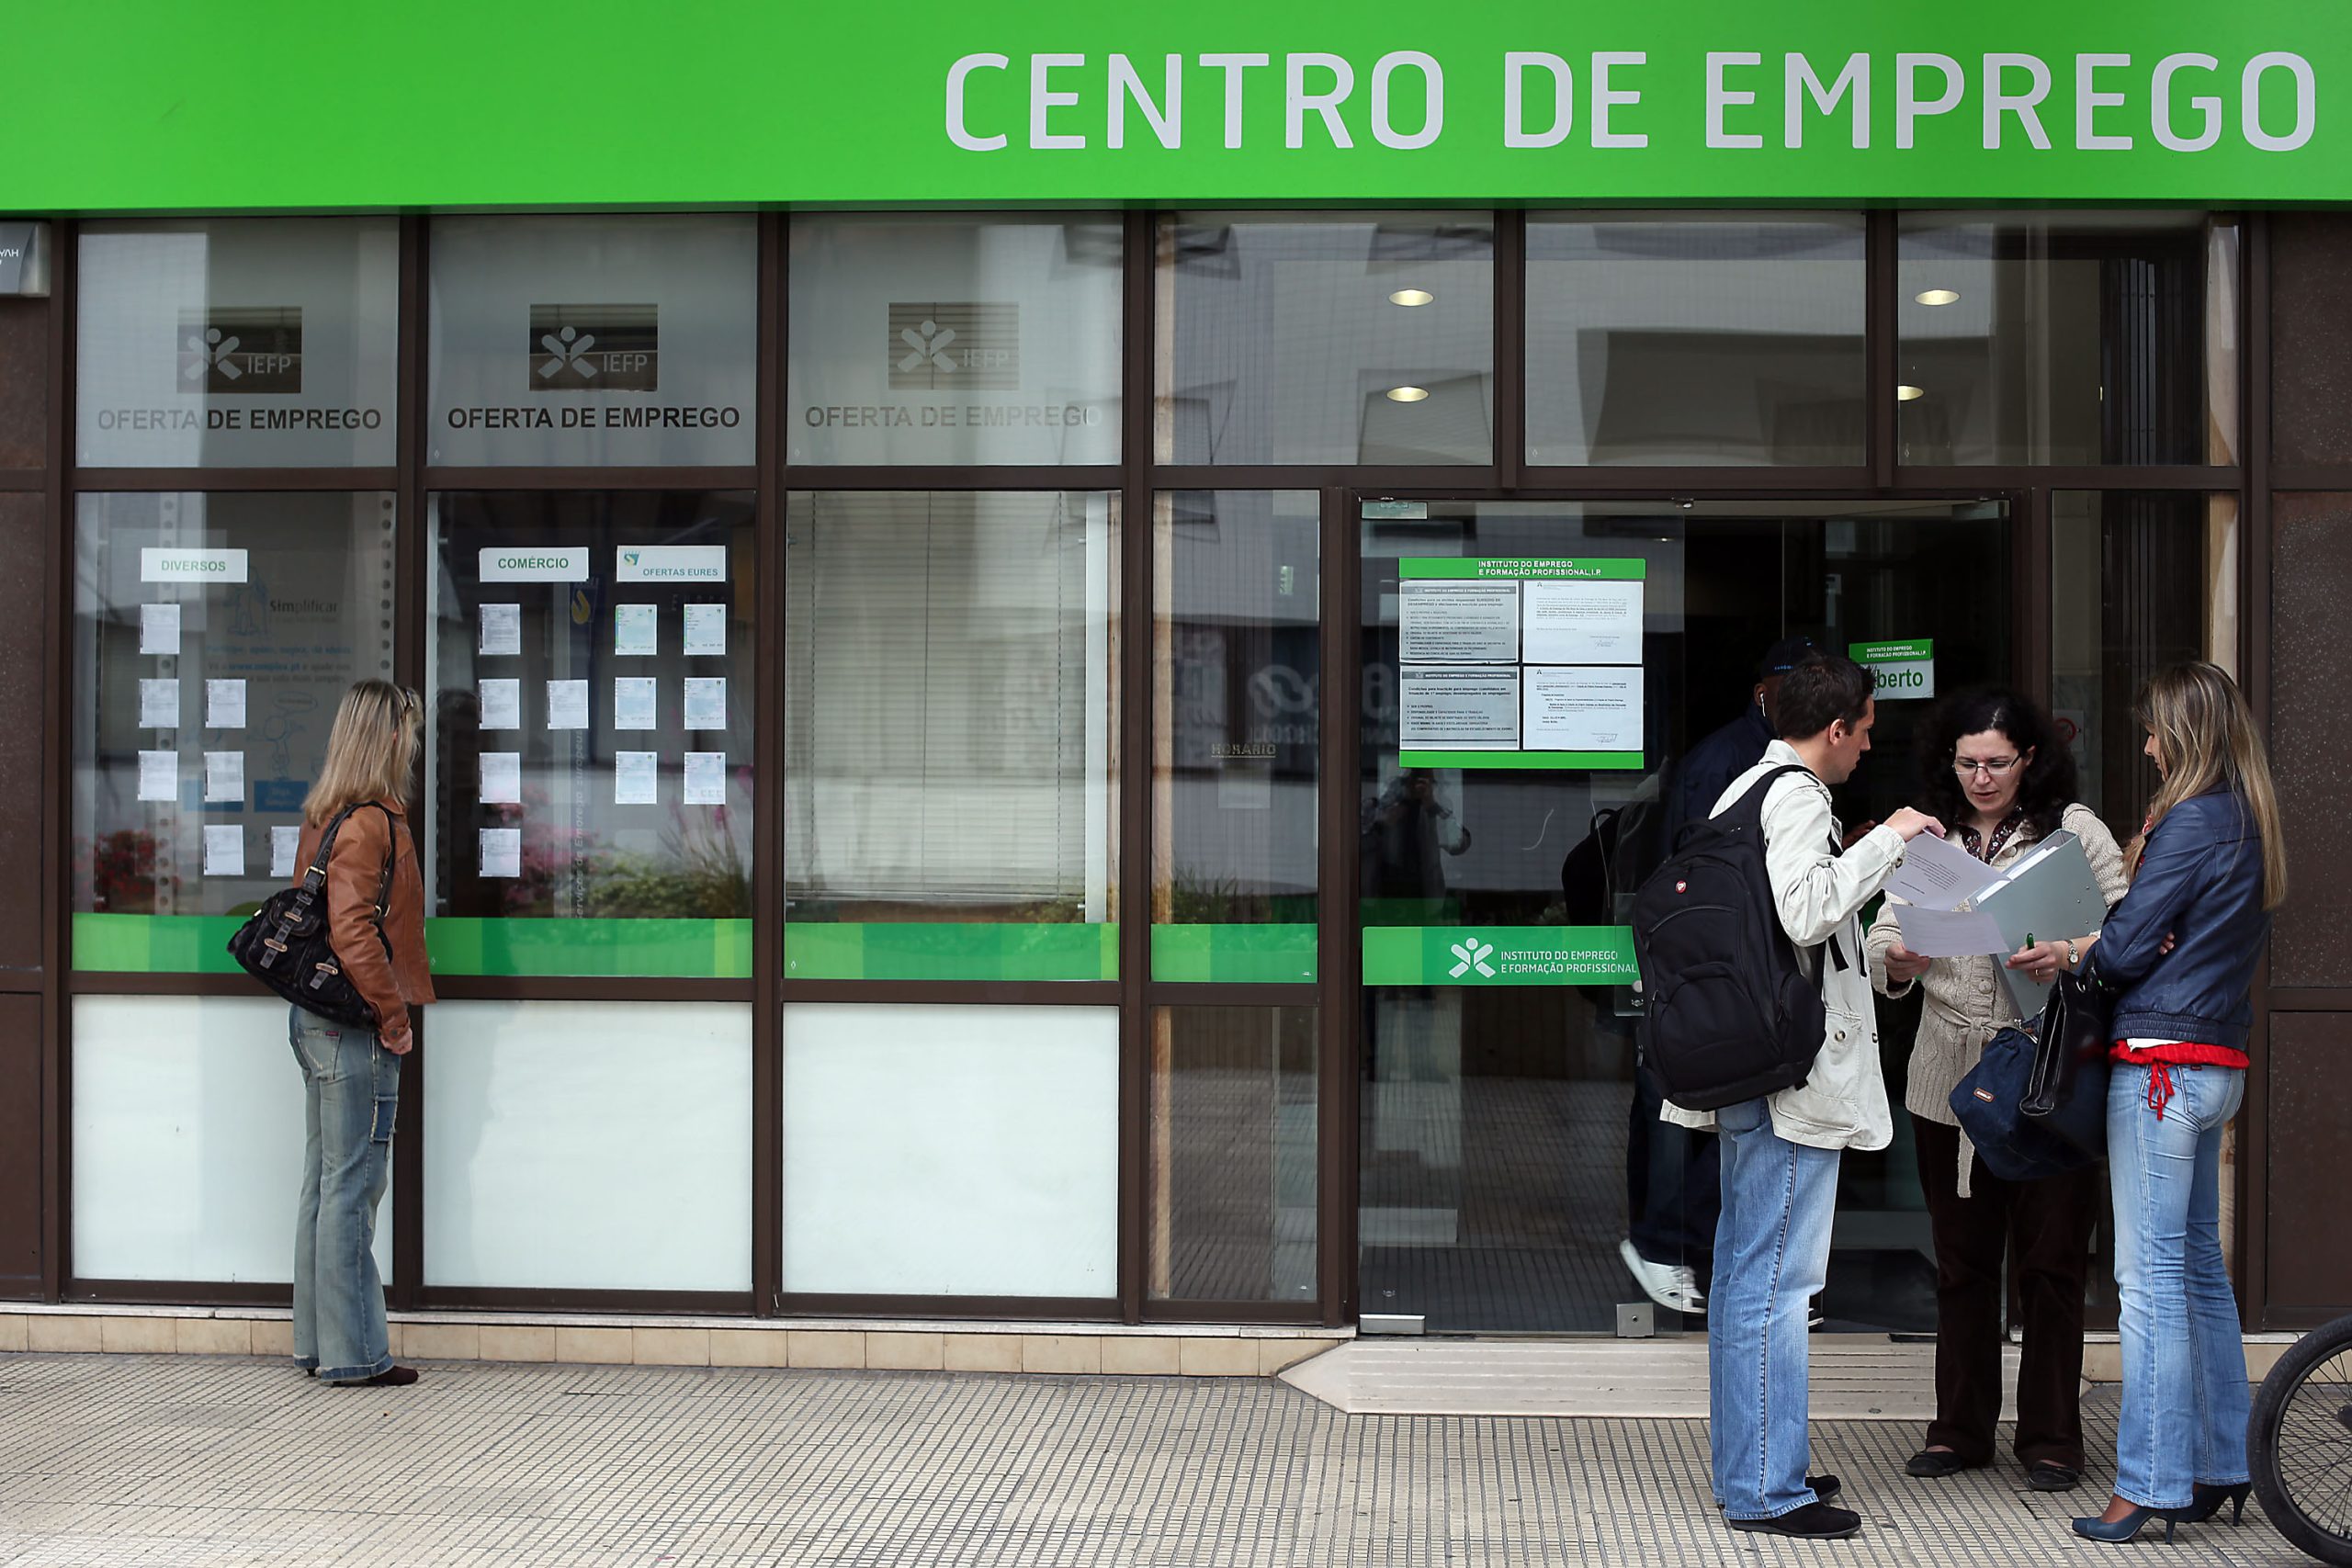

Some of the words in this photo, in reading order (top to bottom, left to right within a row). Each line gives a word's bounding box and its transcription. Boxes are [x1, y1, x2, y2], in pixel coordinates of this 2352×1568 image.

[945, 51, 1443, 152] CENTRO
[1504, 51, 1648, 148] DE
[1706, 51, 2316, 152] EMPREGO
[247, 355, 291, 375] IEFP
[603, 353, 648, 373] IEFP
[964, 348, 1009, 368] IEFP
[98, 409, 199, 431] OFERTA
[207, 410, 241, 430] DE
[250, 409, 381, 431] EMPREGO
[447, 407, 553, 429] OFERTA
[561, 407, 596, 428] DE
[605, 406, 741, 429] EMPREGO
[805, 406, 912, 428] OFERTA
[922, 406, 956, 427] DE
[966, 405, 1102, 428] EMPREGO
[161, 559, 226, 572] DIVERSOS
[497, 555, 570, 569] COMÉRCIO
[1486, 567, 1531, 577] FORMAÇÃO
[643, 568, 685, 577] OFERTAS
[687, 568, 718, 577] EURES
[1876, 668, 1924, 689] berto
[1500, 951, 1553, 961] INSTITUTO
[1555, 951, 1568, 961] DO
[1571, 951, 1618, 961] EMPREGO
[1501, 964, 1507, 974] E
[1510, 962, 1564, 976] FORMAÇÃO
[1566, 964, 1636, 974] PROFISSIONAL
